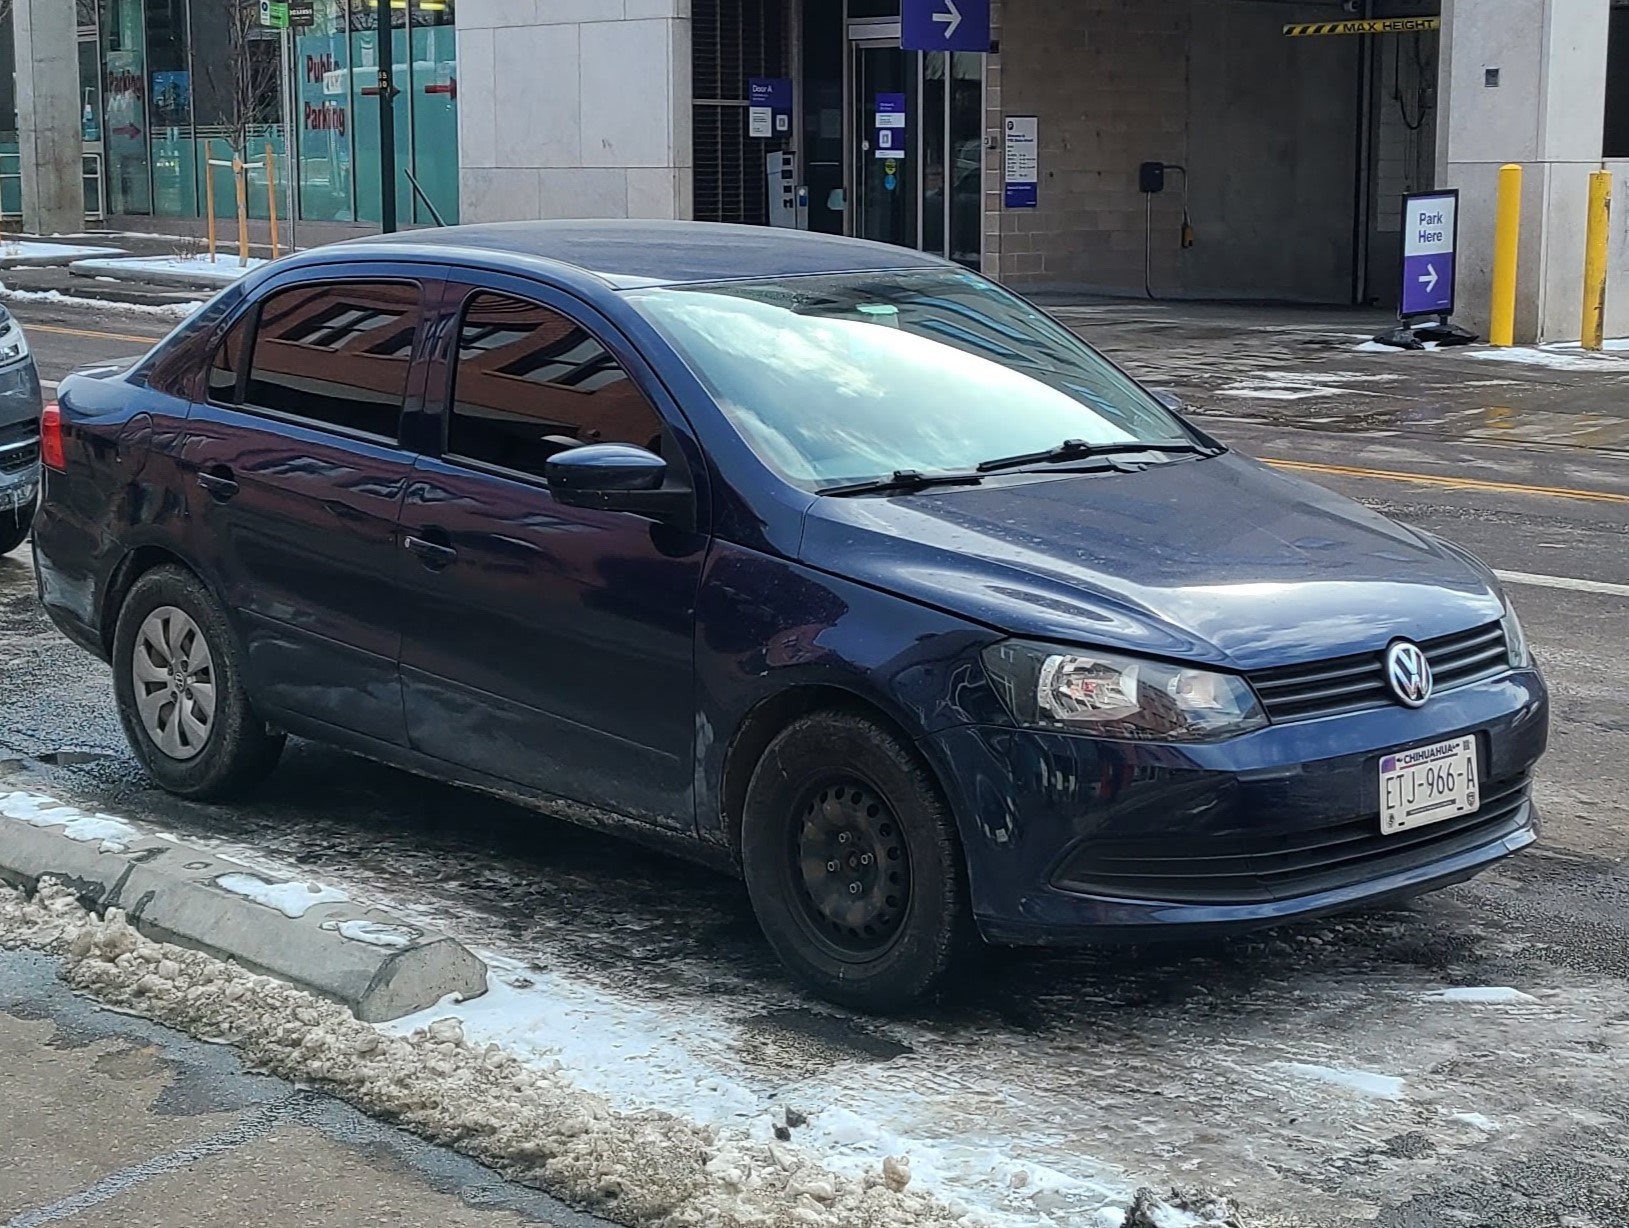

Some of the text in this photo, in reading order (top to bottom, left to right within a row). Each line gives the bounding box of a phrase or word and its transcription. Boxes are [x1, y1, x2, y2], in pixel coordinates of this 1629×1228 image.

[1343, 19, 1434, 33] MAX HEIGHT
[752, 84, 773, 93] Door A
[304, 99, 345, 137] Parking
[1419, 210, 1443, 226] Park
[1418, 228, 1443, 244] Here
[1403, 744, 1454, 764] CHIHUAHUA
[1386, 756, 1476, 811] ETJ-966-A
